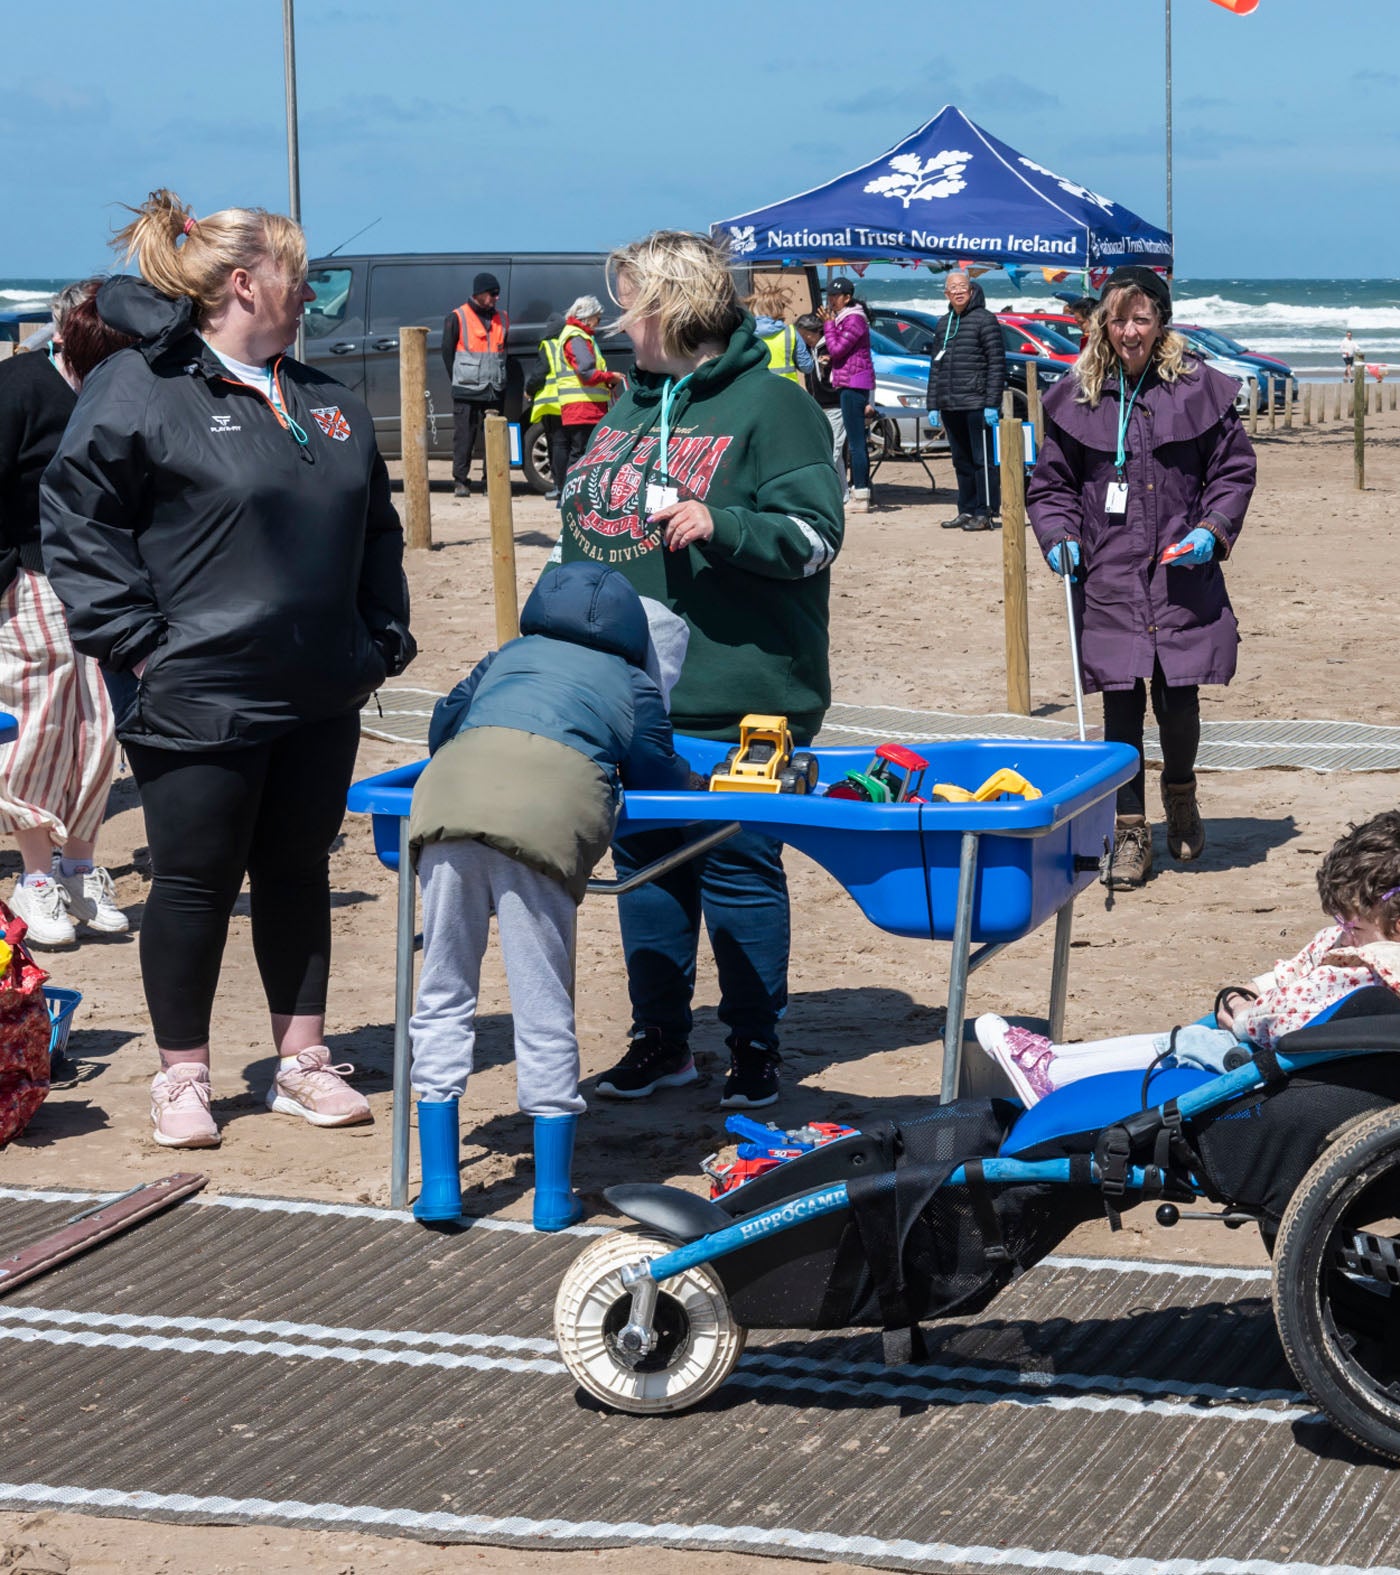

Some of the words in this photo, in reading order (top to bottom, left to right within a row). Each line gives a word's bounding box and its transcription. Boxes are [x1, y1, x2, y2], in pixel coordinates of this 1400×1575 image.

[767, 228, 850, 248] National
[855, 228, 906, 246] Trust
[911, 229, 1002, 250] Northern
[1007, 234, 1077, 254] Ireland
[566, 512, 604, 561] CENTRAL
[591, 513, 635, 534] LEAGUE
